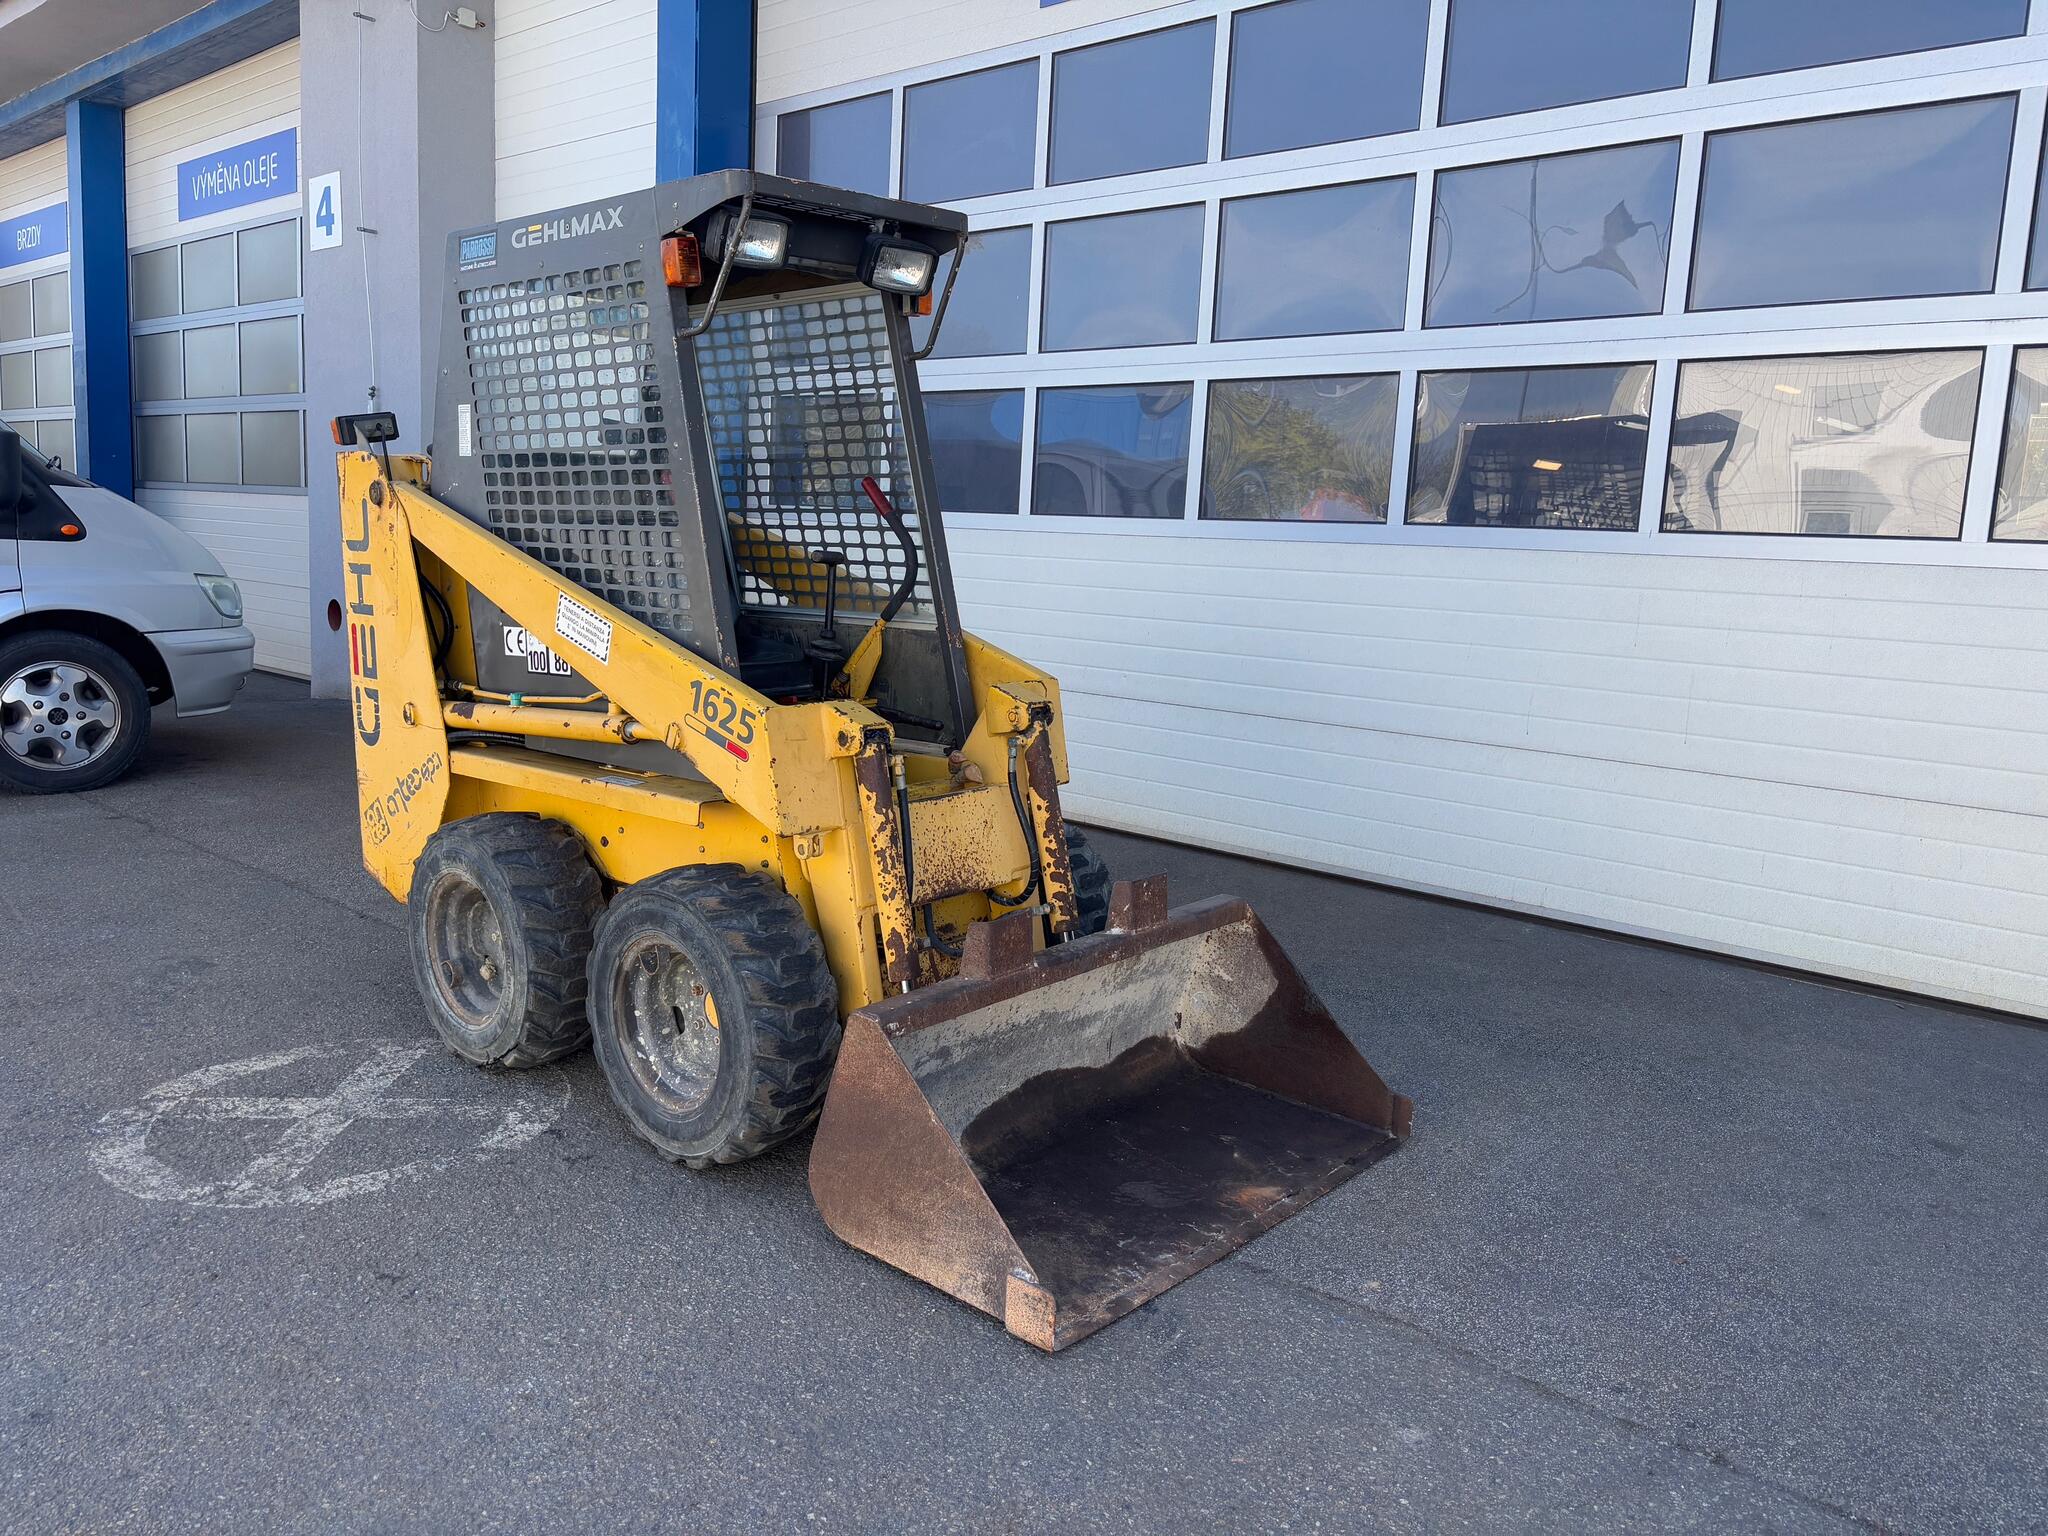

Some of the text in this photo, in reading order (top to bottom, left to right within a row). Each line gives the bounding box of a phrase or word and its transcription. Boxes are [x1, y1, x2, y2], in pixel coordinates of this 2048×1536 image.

[192, 152, 278, 200] VÝMĚNA OLEJE
[316, 185, 335, 236] 4
[511, 205, 624, 249] GEHLMAX
[17, 224, 41, 250] BRZDY
[346, 498, 380, 746] GEHL
[585, 618, 605, 635] DISTANZA
[528, 650, 546, 671] 100
[690, 680, 756, 744] 1625
